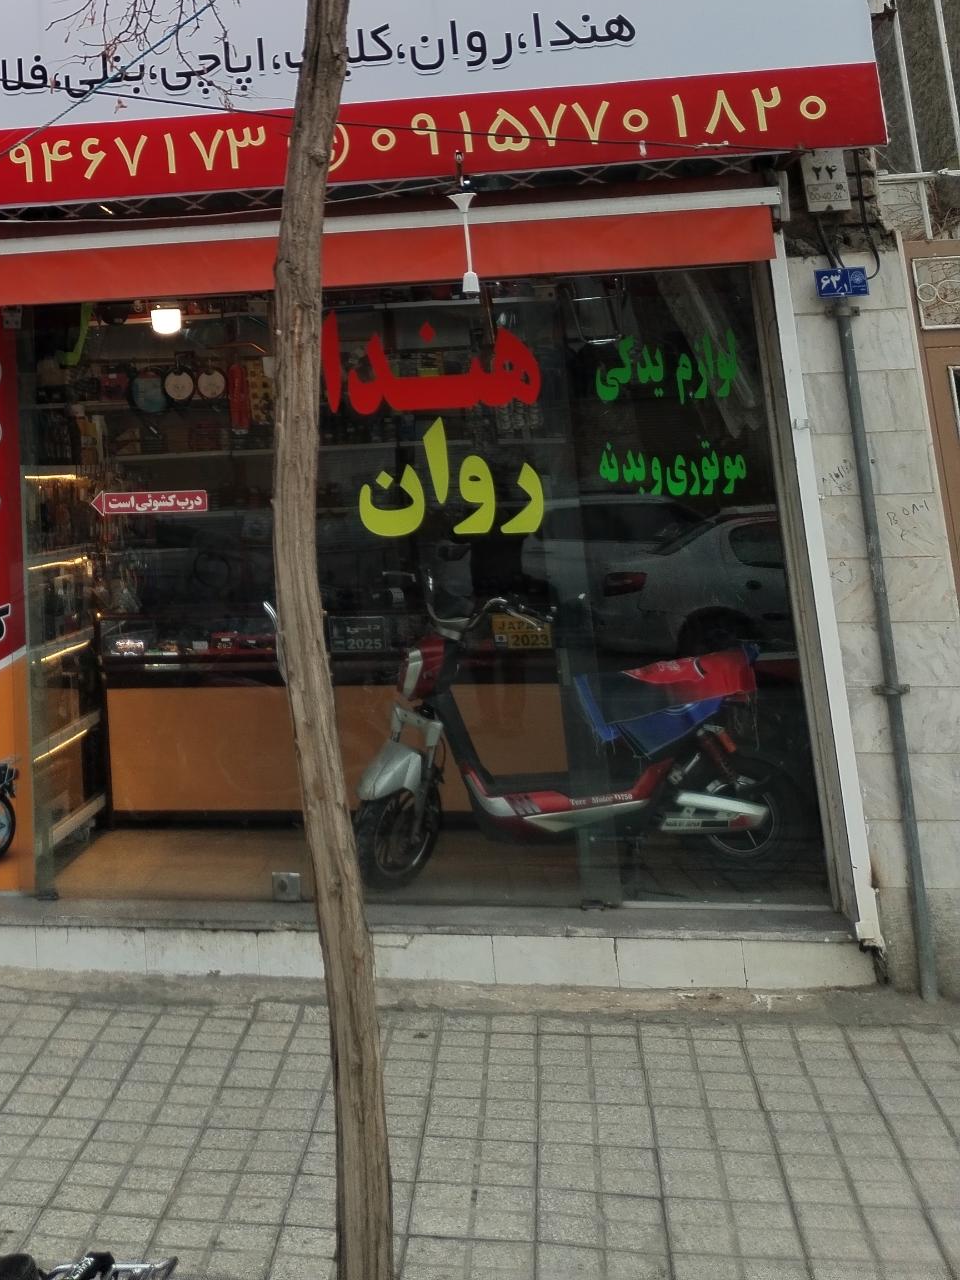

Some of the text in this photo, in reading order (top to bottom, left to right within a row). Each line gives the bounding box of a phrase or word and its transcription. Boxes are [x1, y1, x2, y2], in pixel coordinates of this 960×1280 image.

[372, 87, 828, 155] ۰۹۱۵۷۷۰۱۸۲۰
[321, 310, 542, 416] هندا
[595, 327, 737, 405] لوازم یدکی
[108, 493, 202, 511] درب کشوئی است
[358, 417, 544, 536] روان
[598, 440, 747, 496] موتوری و بدنه
[346, 638, 383, 650] 2025
